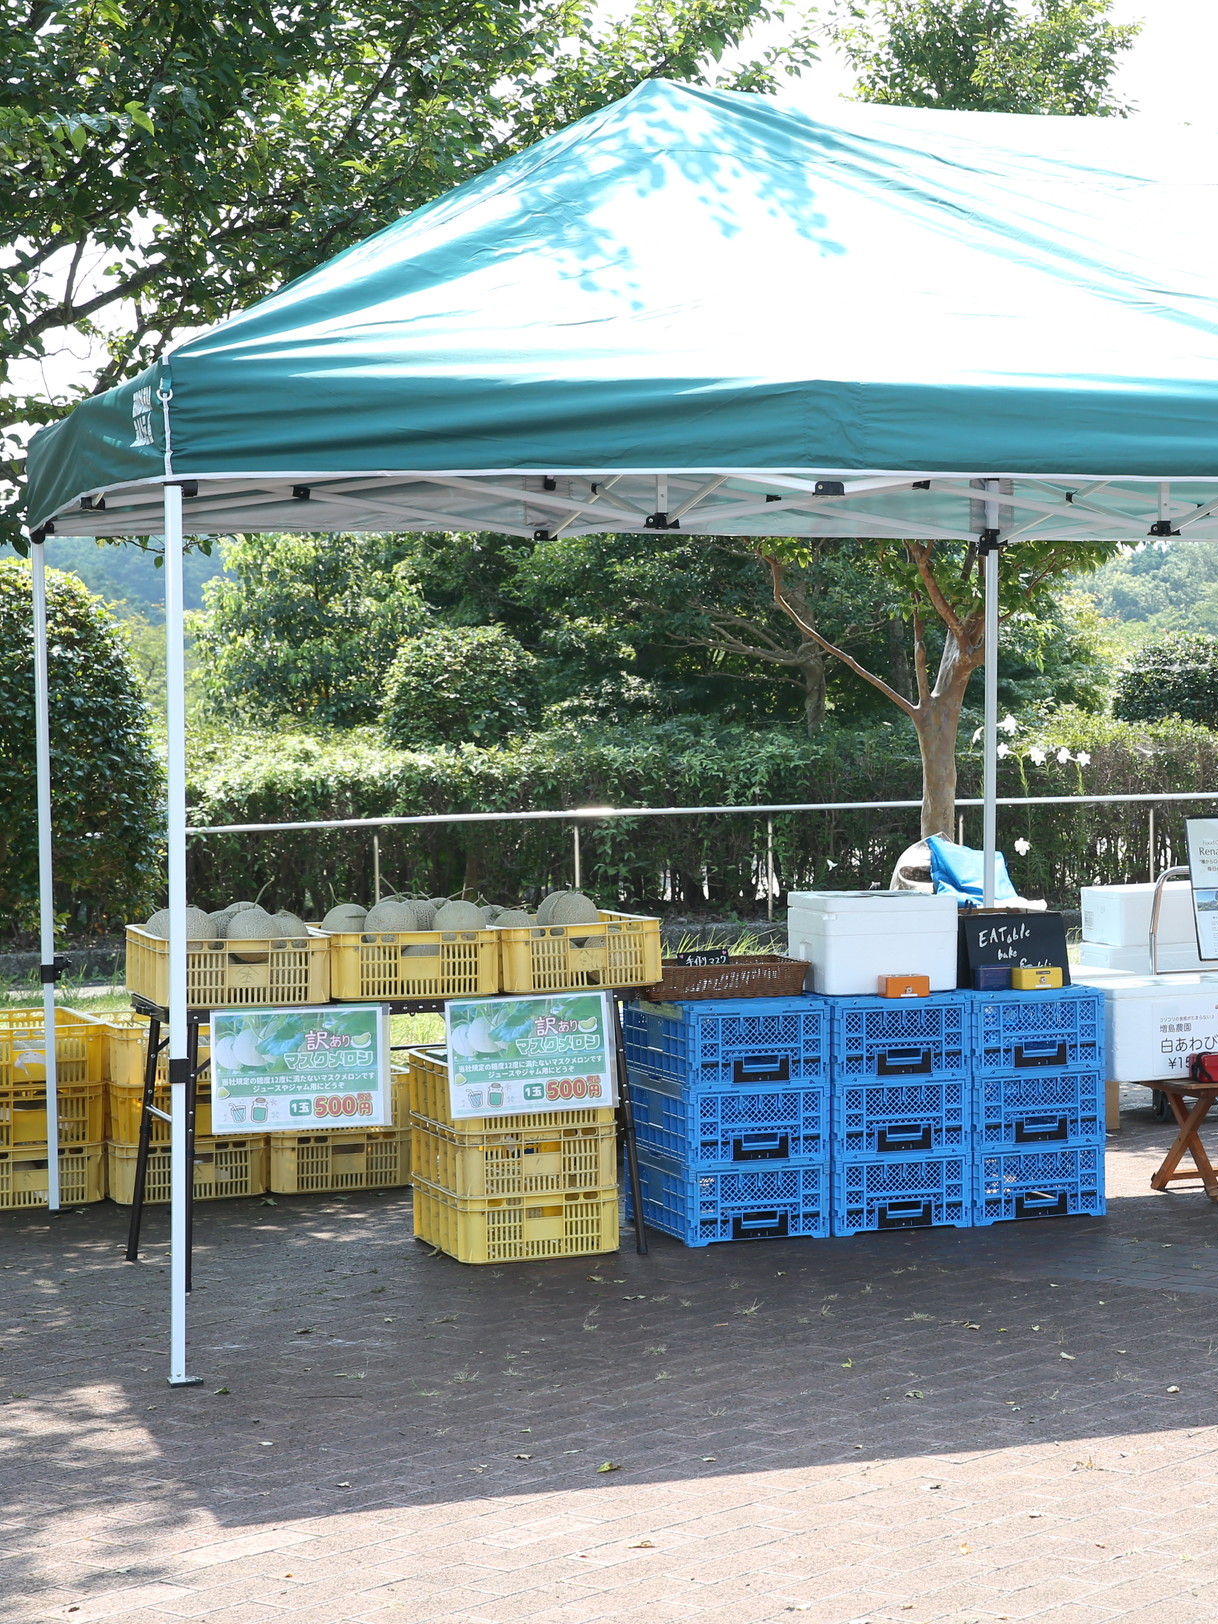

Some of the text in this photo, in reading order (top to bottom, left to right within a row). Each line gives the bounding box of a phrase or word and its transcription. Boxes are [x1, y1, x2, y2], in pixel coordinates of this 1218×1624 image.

[978, 923, 1031, 948] EATable
[534, 1016, 578, 1036] 訳あり
[304, 1030, 350, 1050] 訳あり
[515, 1034, 600, 1055] マスクメロン
[283, 1050, 373, 1070] マスクメロン
[525, 1077, 602, 1101] 1玉 500円
[291, 1094, 373, 1118] 1玉 500円
